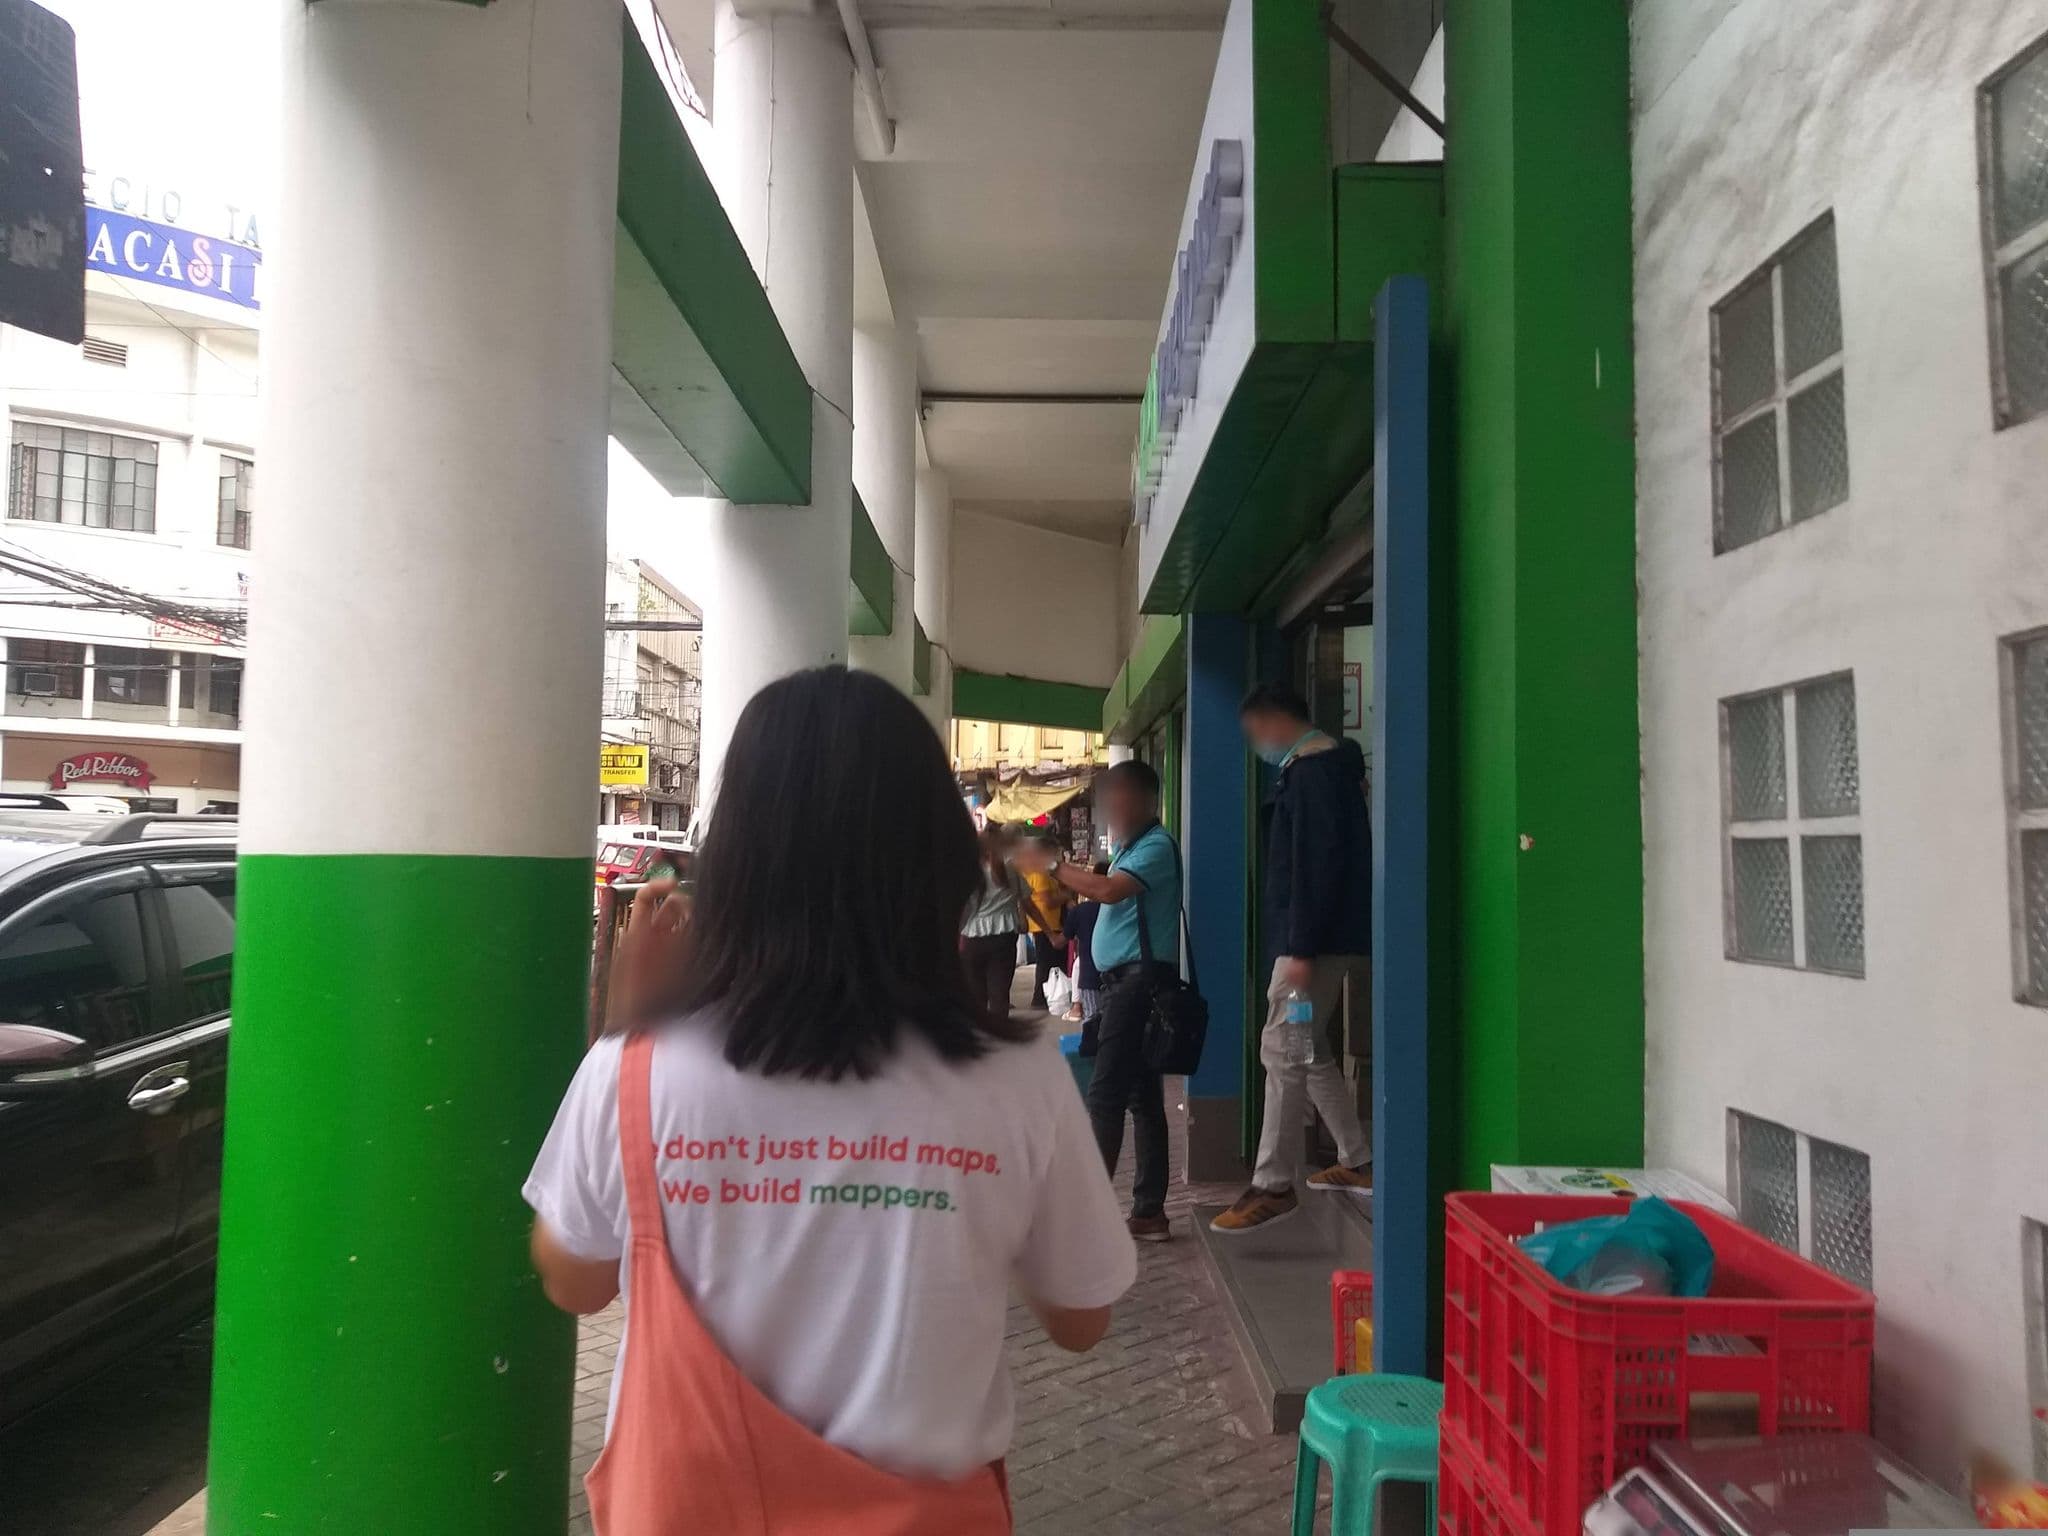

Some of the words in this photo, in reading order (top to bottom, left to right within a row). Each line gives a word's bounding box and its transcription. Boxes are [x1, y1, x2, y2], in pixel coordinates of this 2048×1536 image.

[62, 758, 92, 782] Red
[92, 756, 142, 777] Ribbon
[664, 1133, 750, 1161] don't
[754, 1132, 820, 1167] just
[827, 1134, 910, 1163] build
[916, 1142, 1002, 1177] maps.
[662, 1178, 711, 1205] We
[719, 1177, 802, 1205] build
[810, 1182, 958, 1213] mappers.
